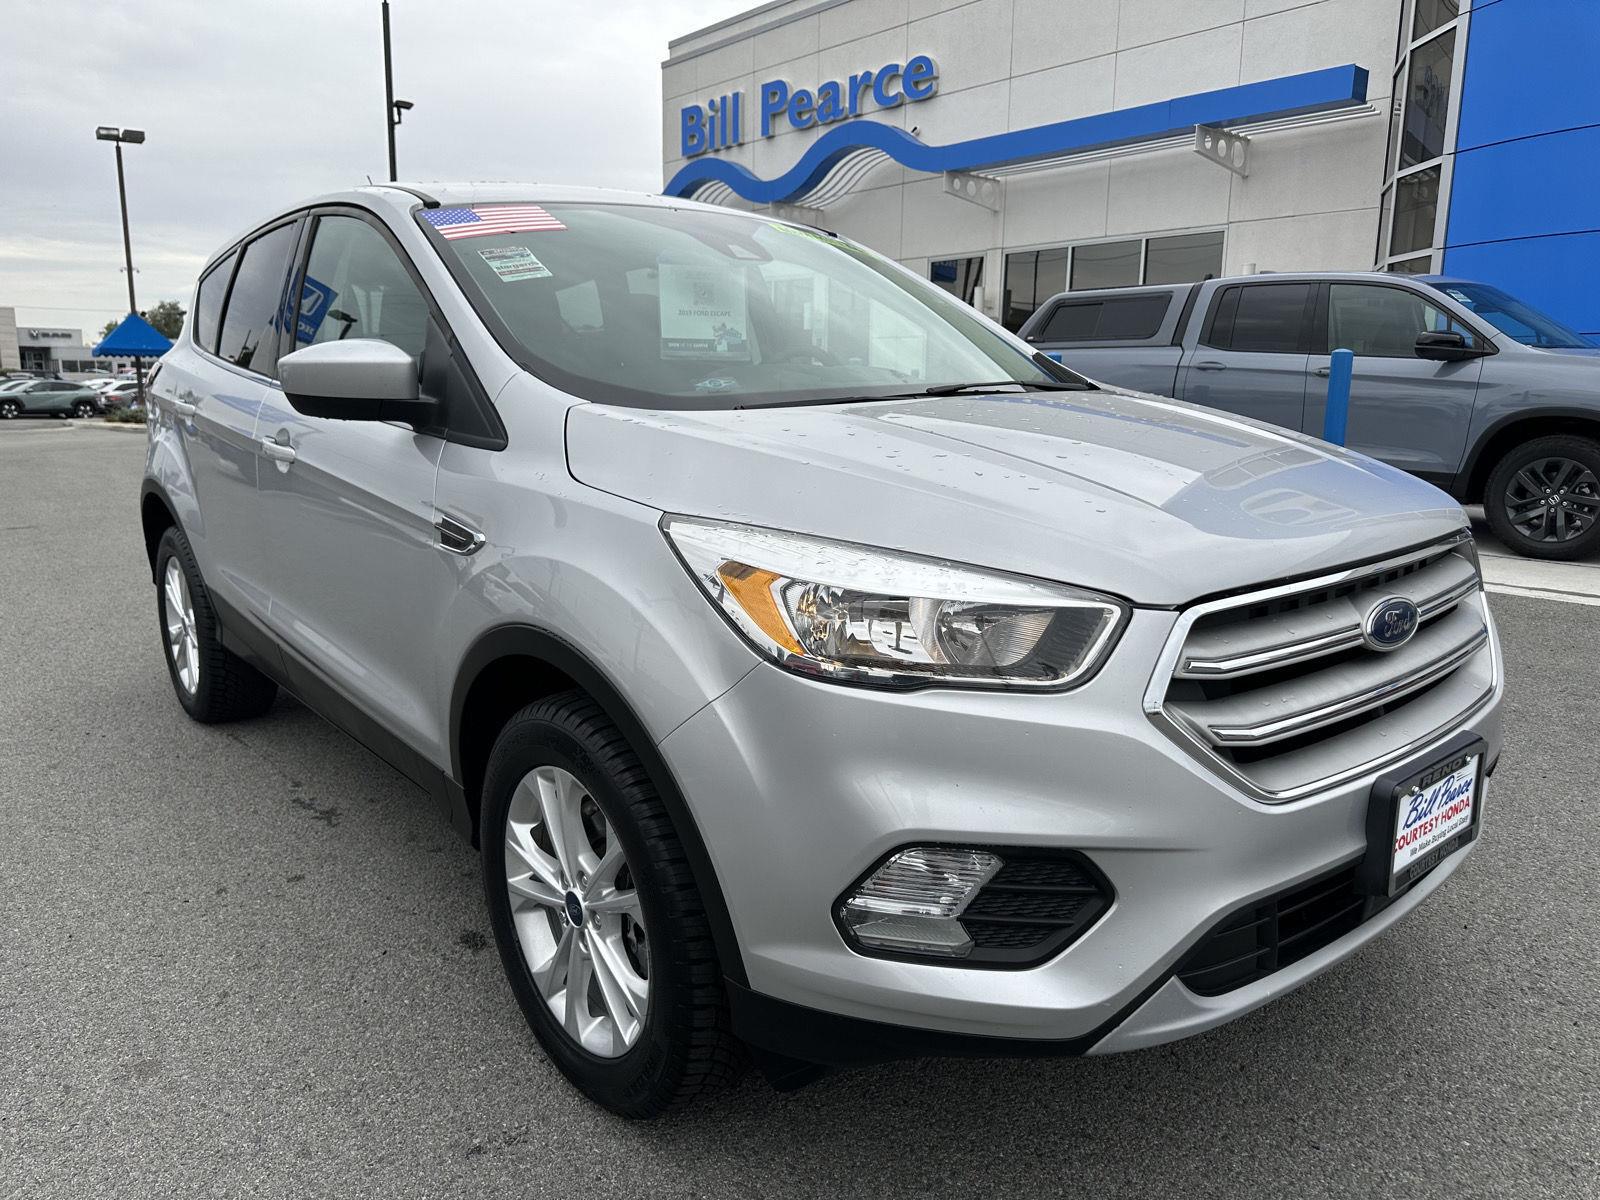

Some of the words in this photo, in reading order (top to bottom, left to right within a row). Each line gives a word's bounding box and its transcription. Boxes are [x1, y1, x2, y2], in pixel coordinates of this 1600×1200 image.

[681, 91, 742, 157] Bill
[761, 55, 936, 137] Pearce
[1384, 608, 1410, 638] Ford
[1422, 758, 1462, 787] RENO
[1403, 785, 1442, 830] Bill
[1437, 775, 1473, 810] Pearce
[1441, 795, 1470, 825] HONDA
[1418, 839, 1431, 852] Make
[1431, 829, 1447, 844] Buying
[1447, 818, 1459, 833] Local
[1409, 850, 1440, 879] COURTESY
[1440, 837, 1459, 859] HONDA
